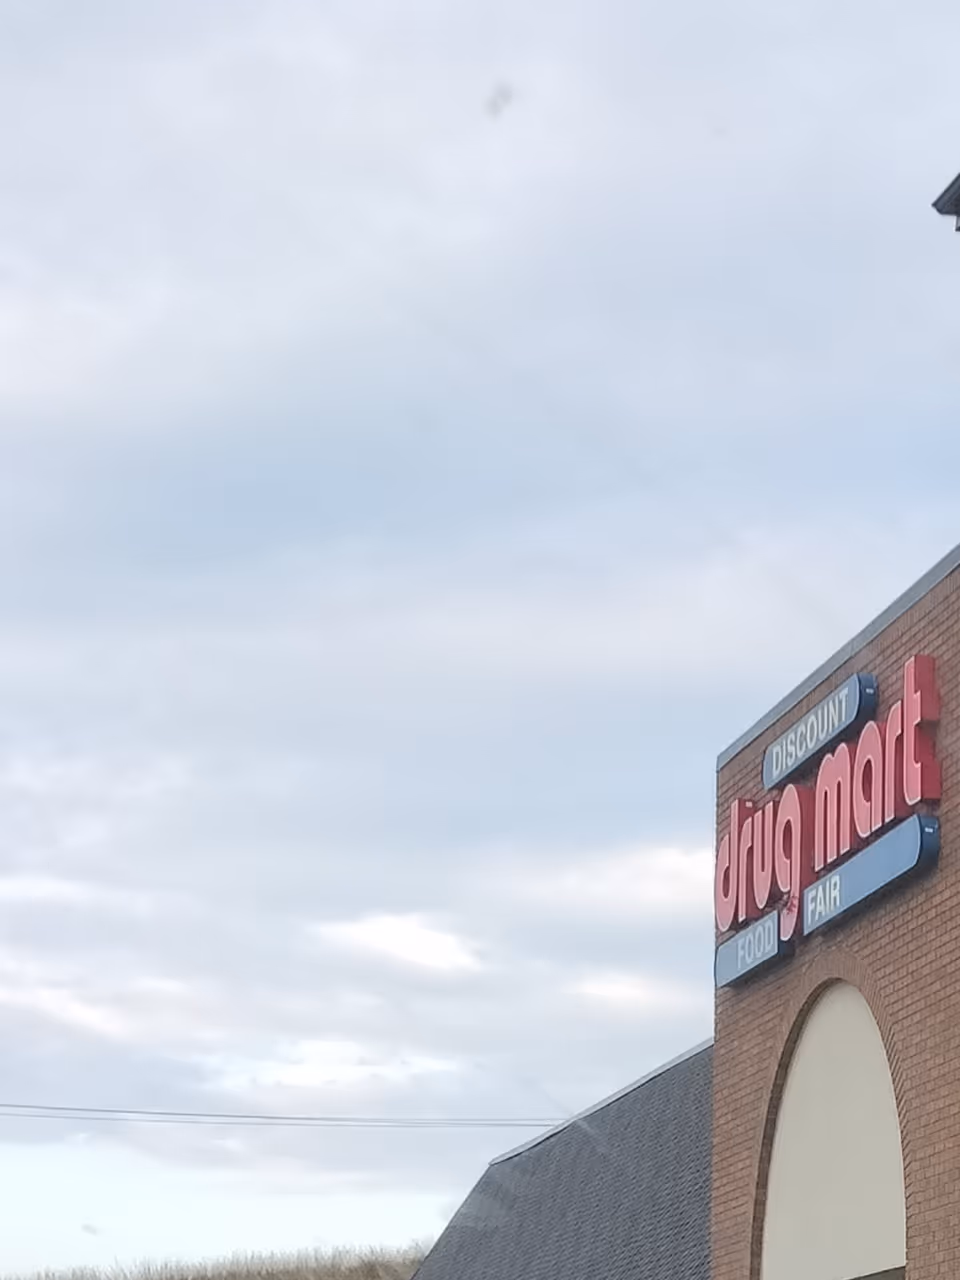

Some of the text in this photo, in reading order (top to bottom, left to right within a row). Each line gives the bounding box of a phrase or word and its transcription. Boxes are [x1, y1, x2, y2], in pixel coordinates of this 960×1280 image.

[771, 687, 849, 779] DISCOUNT
[715, 656, 922, 940] drug mart
[736, 875, 841, 969] FOOD FAIR
